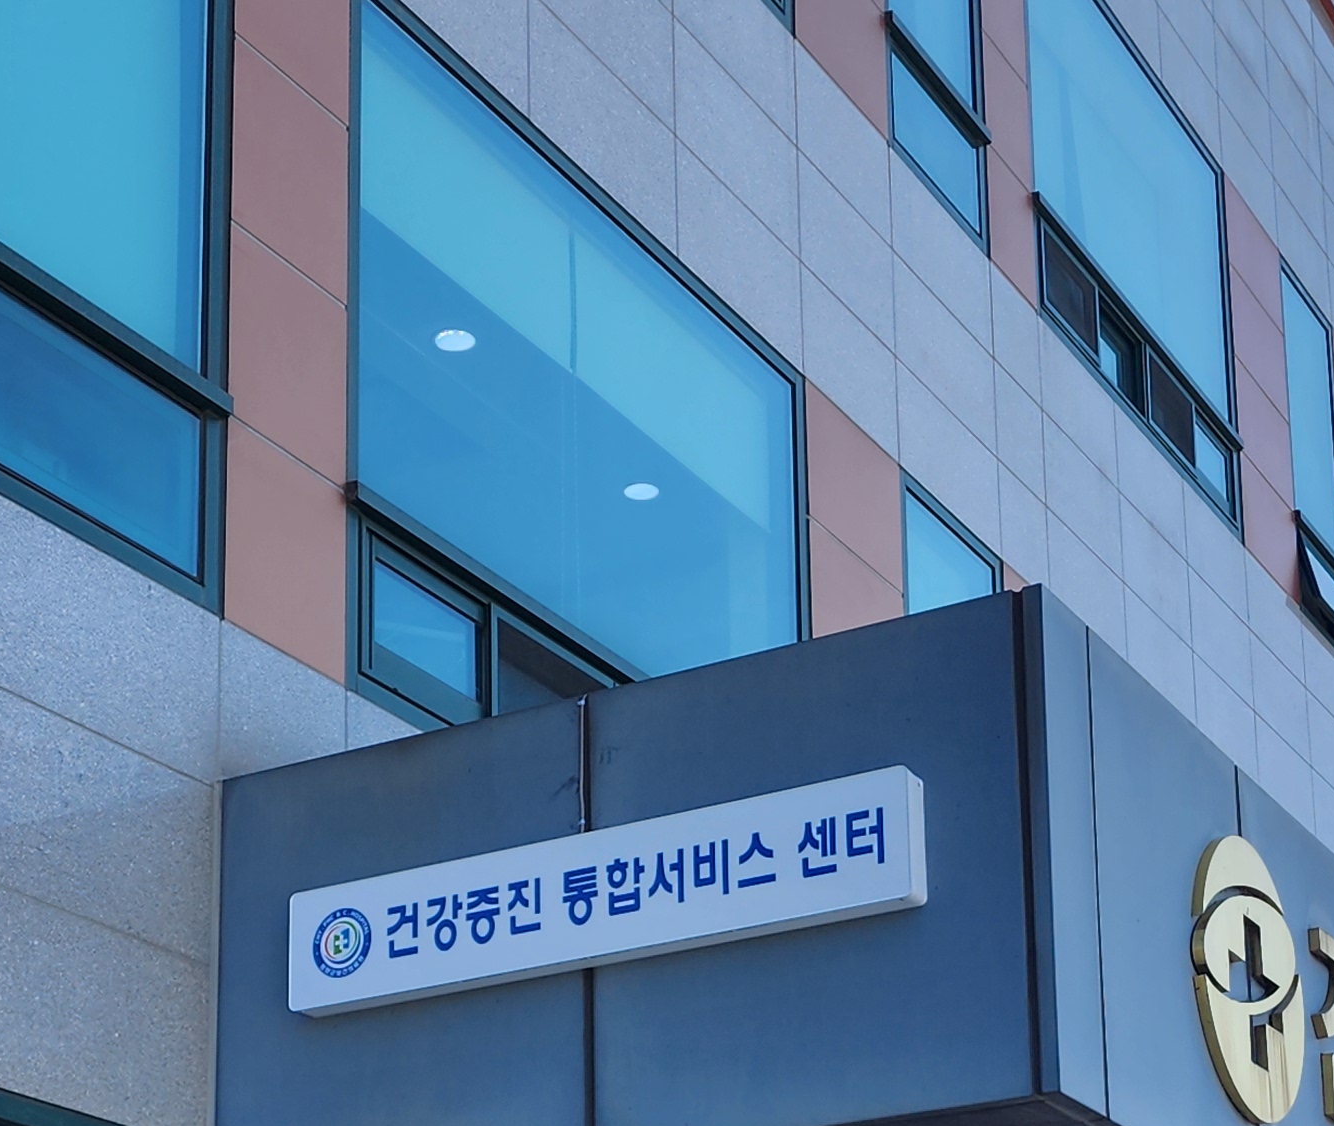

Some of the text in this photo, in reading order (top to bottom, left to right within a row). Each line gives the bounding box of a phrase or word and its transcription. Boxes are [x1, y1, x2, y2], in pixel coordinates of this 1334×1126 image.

[384, 806, 887, 959] 건강증진 통합서비스 센터
